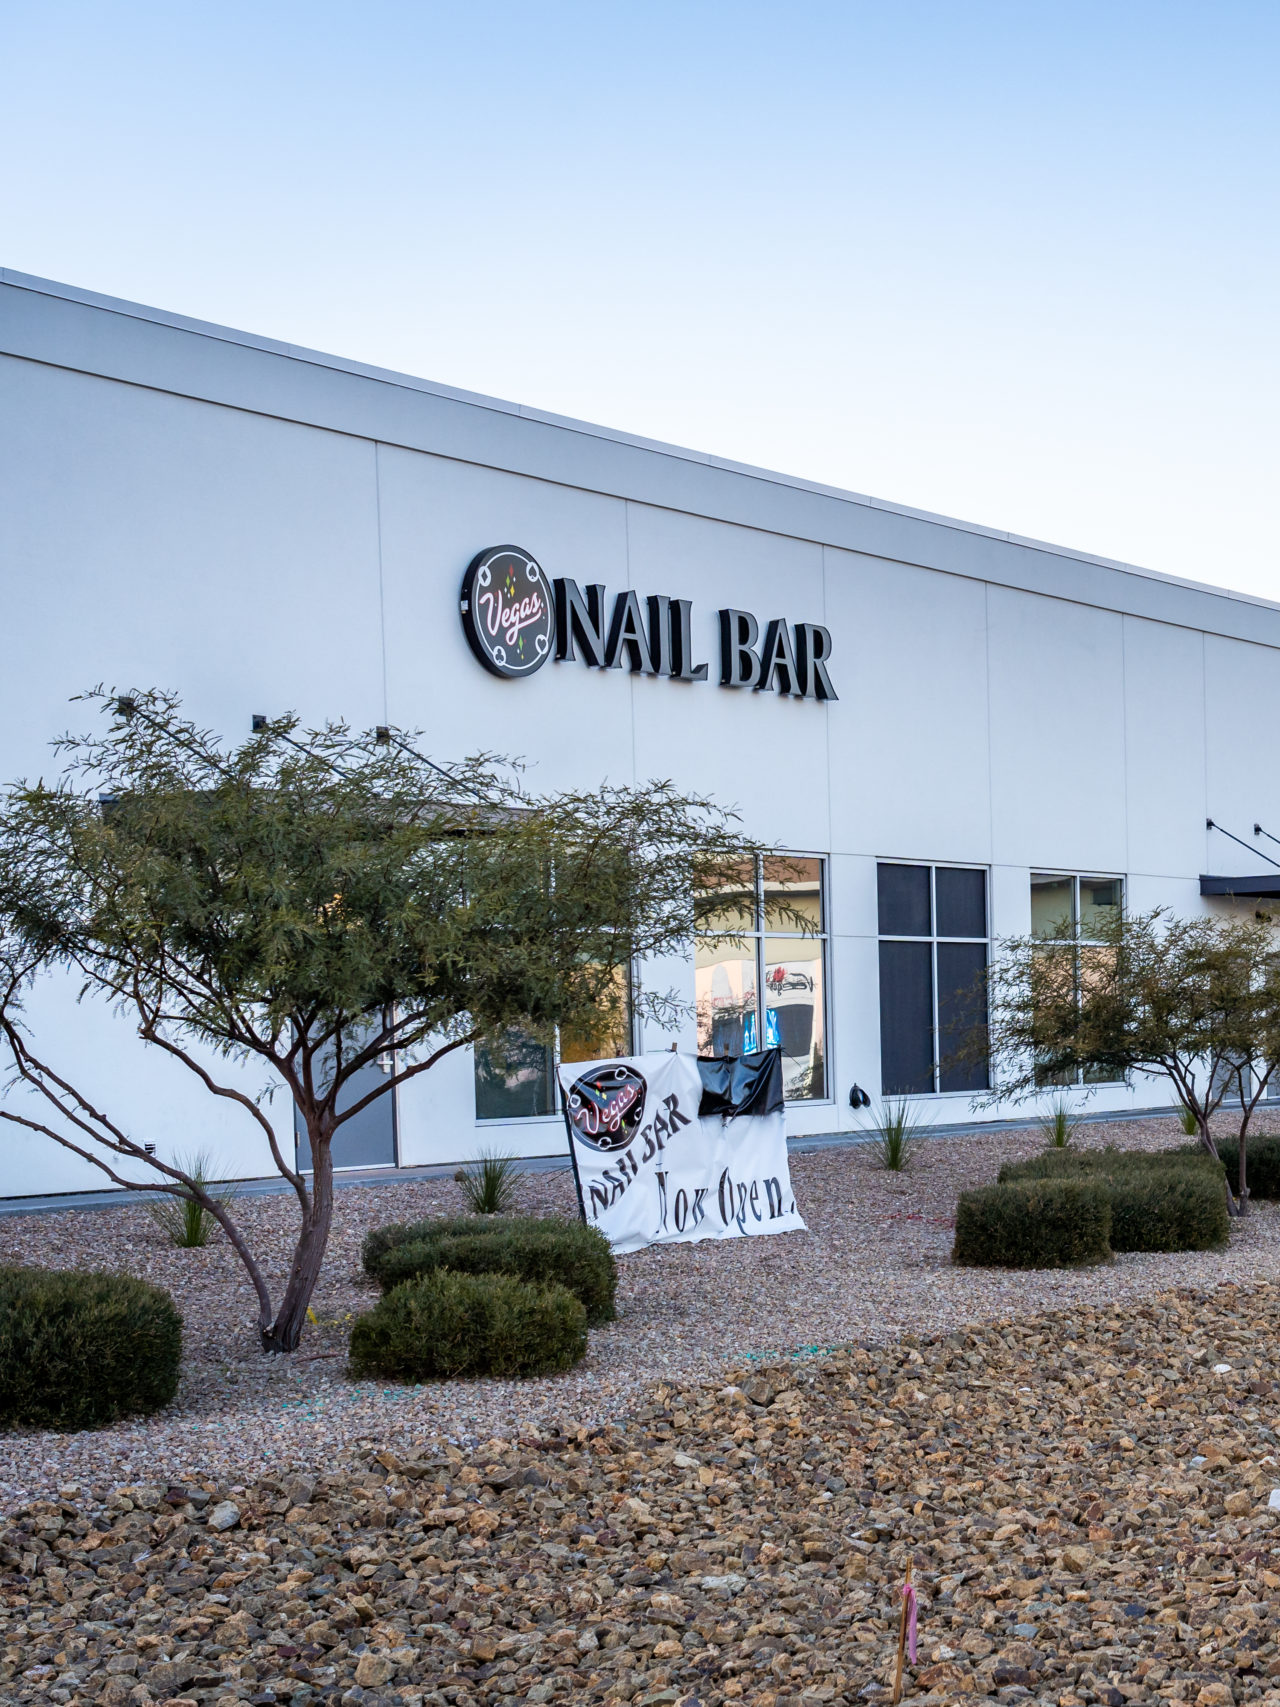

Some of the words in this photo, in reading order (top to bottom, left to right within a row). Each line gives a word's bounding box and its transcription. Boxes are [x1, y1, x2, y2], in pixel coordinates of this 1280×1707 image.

[480, 590, 541, 646] Vegas
[553, 578, 708, 681] NAIL
[718, 609, 839, 701] BAR
[574, 1083, 639, 1134] Vegas
